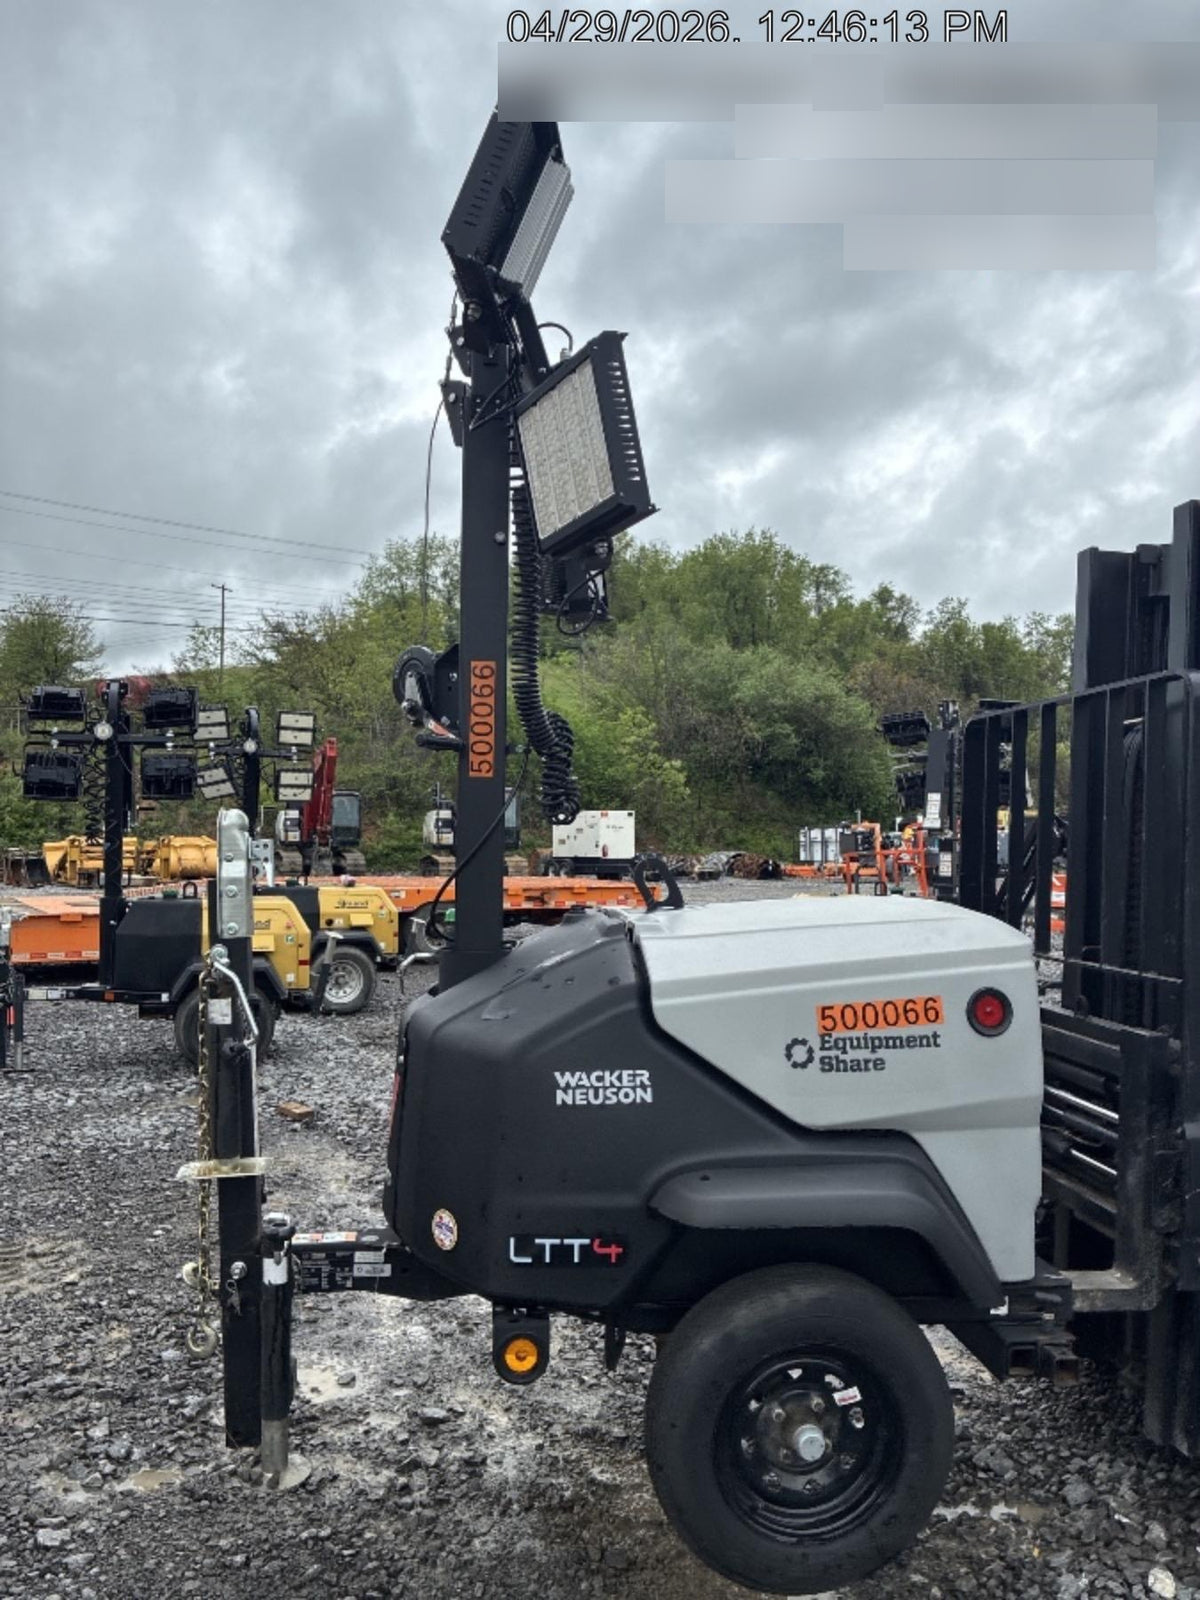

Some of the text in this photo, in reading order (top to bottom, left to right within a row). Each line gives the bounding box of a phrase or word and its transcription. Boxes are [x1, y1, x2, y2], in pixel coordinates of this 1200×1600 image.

[471, 665, 494, 774] 500066
[820, 997, 940, 1032] 500066
[819, 1031, 941, 1054] Equipment
[819, 1055, 886, 1073] Share
[553, 1070, 652, 1088] WACKER
[556, 1087, 653, 1105] NEUSON
[509, 1237, 623, 1263] LTT4
